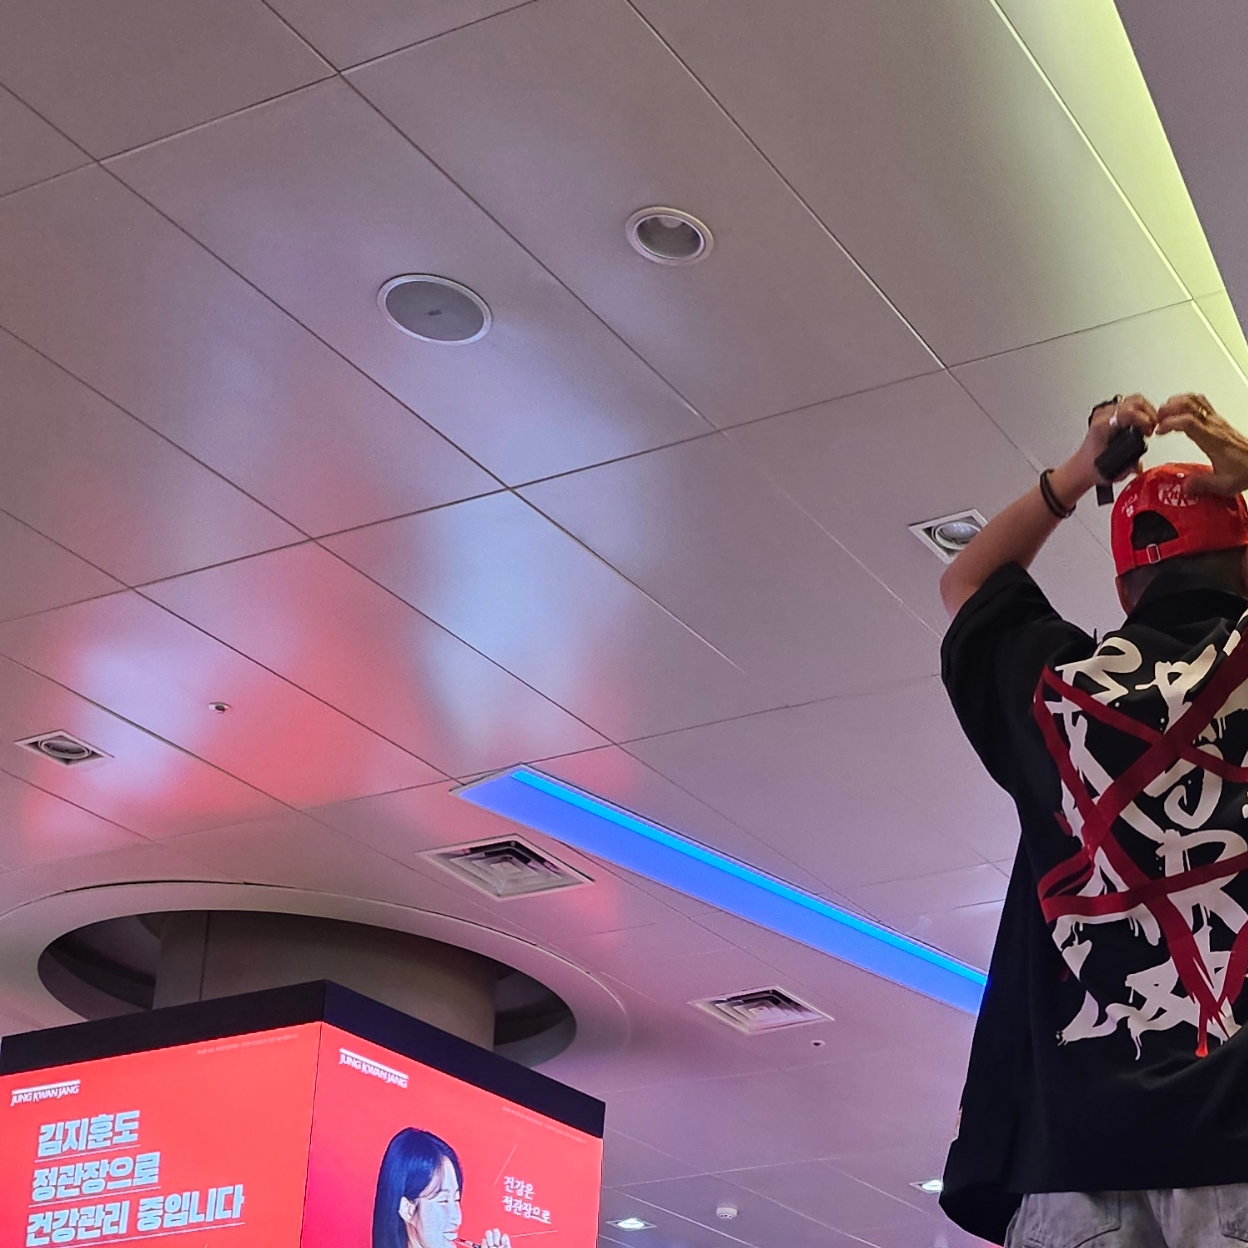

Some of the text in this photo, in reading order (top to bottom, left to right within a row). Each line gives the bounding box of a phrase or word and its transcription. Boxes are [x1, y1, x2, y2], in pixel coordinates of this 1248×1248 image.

[338, 1053, 362, 1071] JUNG
[386, 1071, 408, 1089] JANG
[11, 1084, 80, 1106] JUNG KWAN JANG
[37, 1109, 141, 1158] 김지훈도
[31, 1151, 161, 1202] 정관장으로
[503, 1175, 535, 1201] 건강은
[25, 1184, 245, 1248] 건강관리 중입니다
[502, 1195, 552, 1225] 정관장으로
